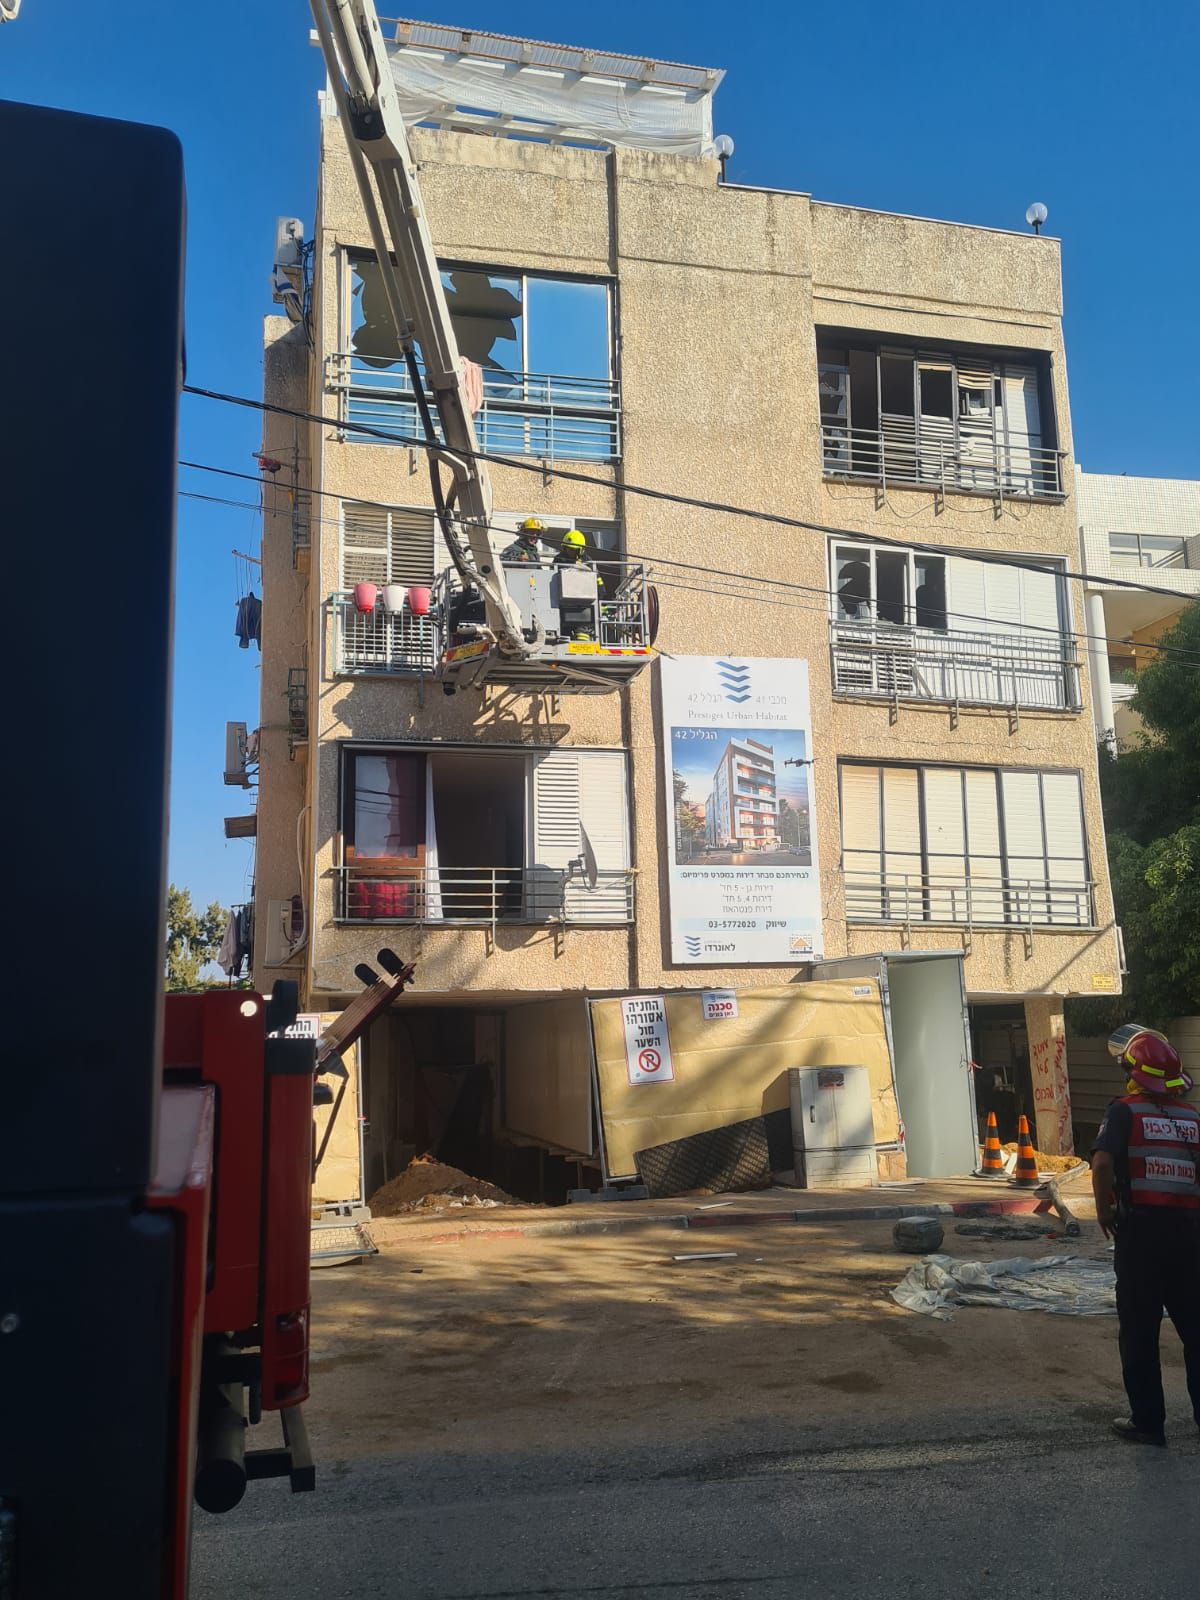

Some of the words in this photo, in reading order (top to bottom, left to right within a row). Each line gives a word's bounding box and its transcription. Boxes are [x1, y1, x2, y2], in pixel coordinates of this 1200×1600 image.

[688, 694, 698, 703] 42
[727, 712, 753, 720] Urban
[756, 712, 787, 720] Habitat
[675, 730, 687, 739] 42
[690, 729, 718, 740] הגליל
[776, 871, 809, 879] לבחירתכם
[752, 895, 772, 903] דירות
[708, 920, 757, 928] 03-5772020
[765, 920, 787, 930] שיווק
[704, 943, 736, 952] לאונרדו
[628, 1000, 659, 1012] החניה
[708, 1002, 733, 1011] סכנה
[626, 1011, 663, 1024] אסורה!
[638, 1025, 654, 1036] מול
[634, 1037, 661, 1048] השער
[1145, 1122, 1172, 1134] כיבוי
[1147, 1159, 1175, 1177] והצלה
